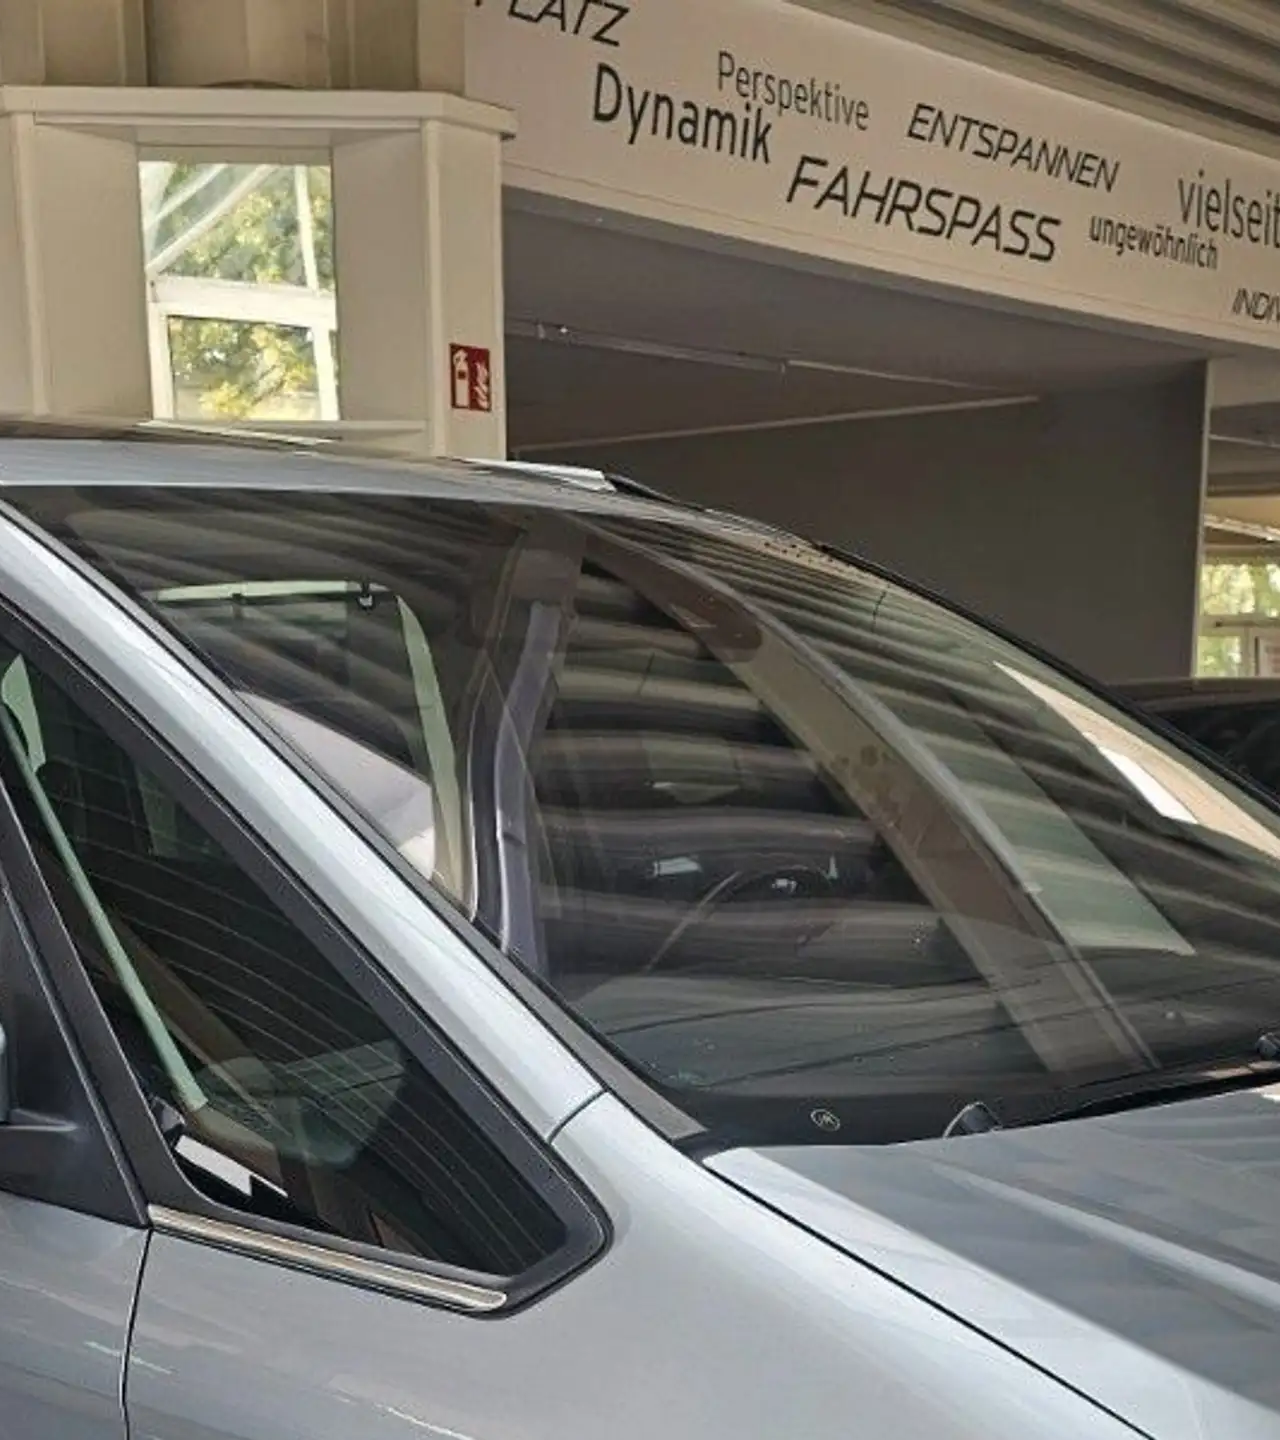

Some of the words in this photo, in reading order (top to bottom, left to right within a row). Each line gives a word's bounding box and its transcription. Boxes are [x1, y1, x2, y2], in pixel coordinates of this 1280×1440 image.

[474, 0, 629, 47] LATZ
[593, 62, 771, 164] Dynamik
[718, 50, 870, 131] Perspektive
[907, 102, 1121, 193] ENTSPANNEN
[786, 155, 1061, 262] FAHRSPASS
[1089, 215, 1218, 270] ungewöhnlich
